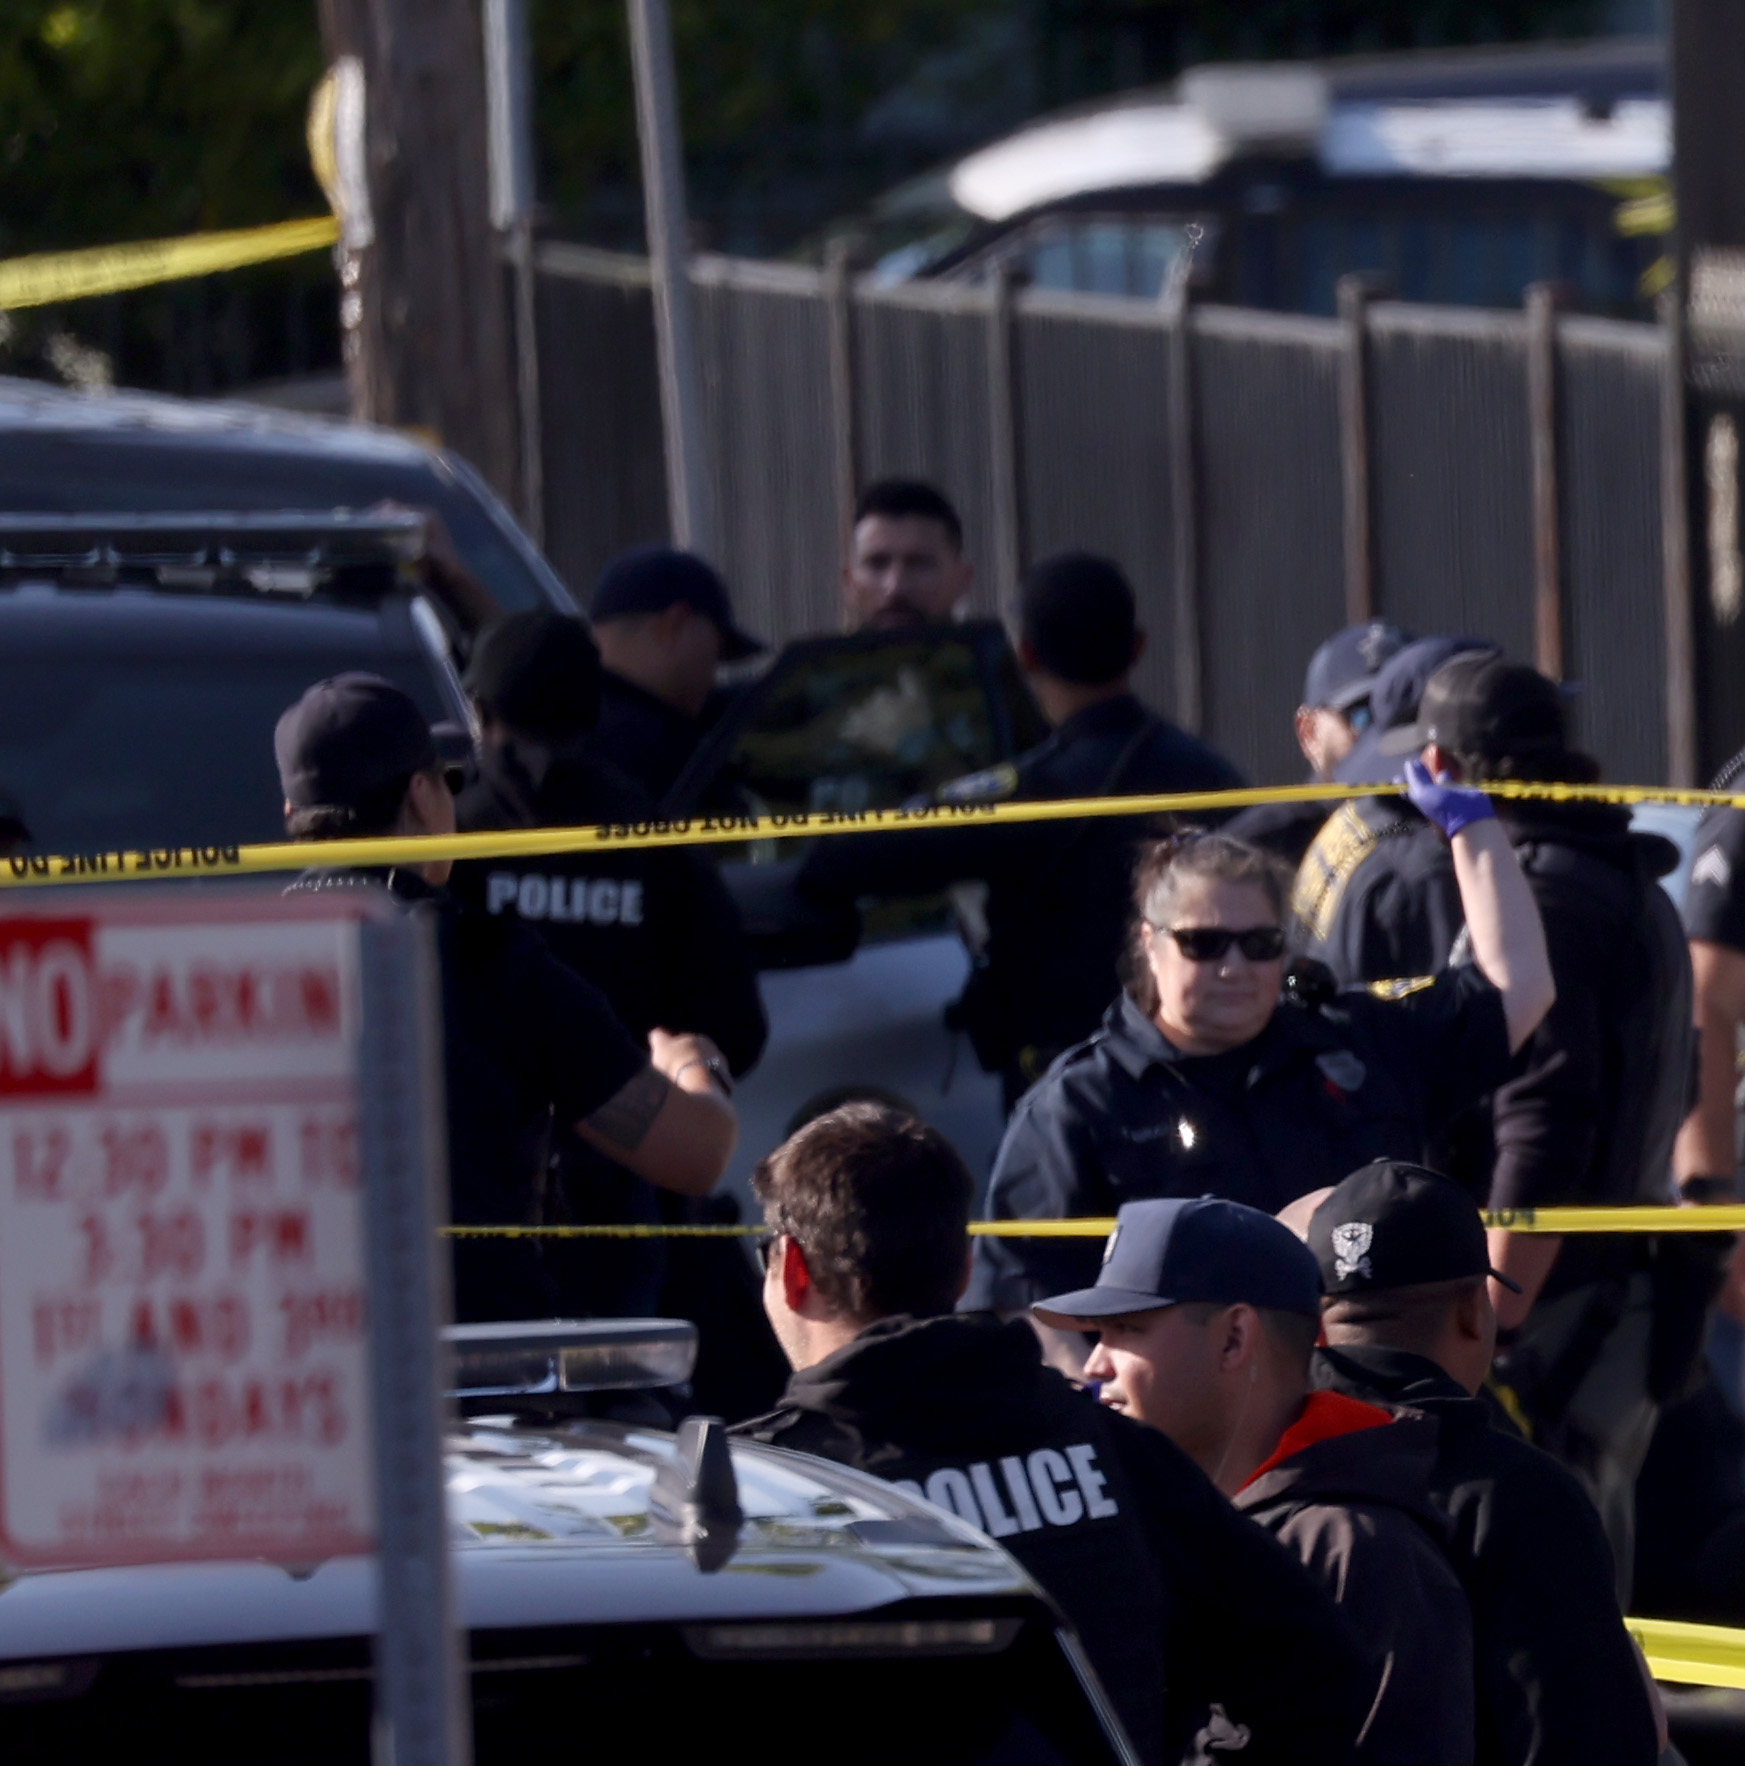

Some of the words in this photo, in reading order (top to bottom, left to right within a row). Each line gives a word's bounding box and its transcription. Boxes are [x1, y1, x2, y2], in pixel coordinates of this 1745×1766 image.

[595, 817, 691, 841] CROSS
[701, 815, 758, 835] NOT
[10, 854, 46, 878] DO
[60, 850, 133, 875] LINE
[136, 844, 240, 870] POLICE
[487, 872, 644, 926] POLICE
[0, 940, 90, 1078] NO
[98, 960, 343, 1046] PARKIN
[190, 1118, 274, 1192] PM
[230, 1203, 313, 1272] PM
